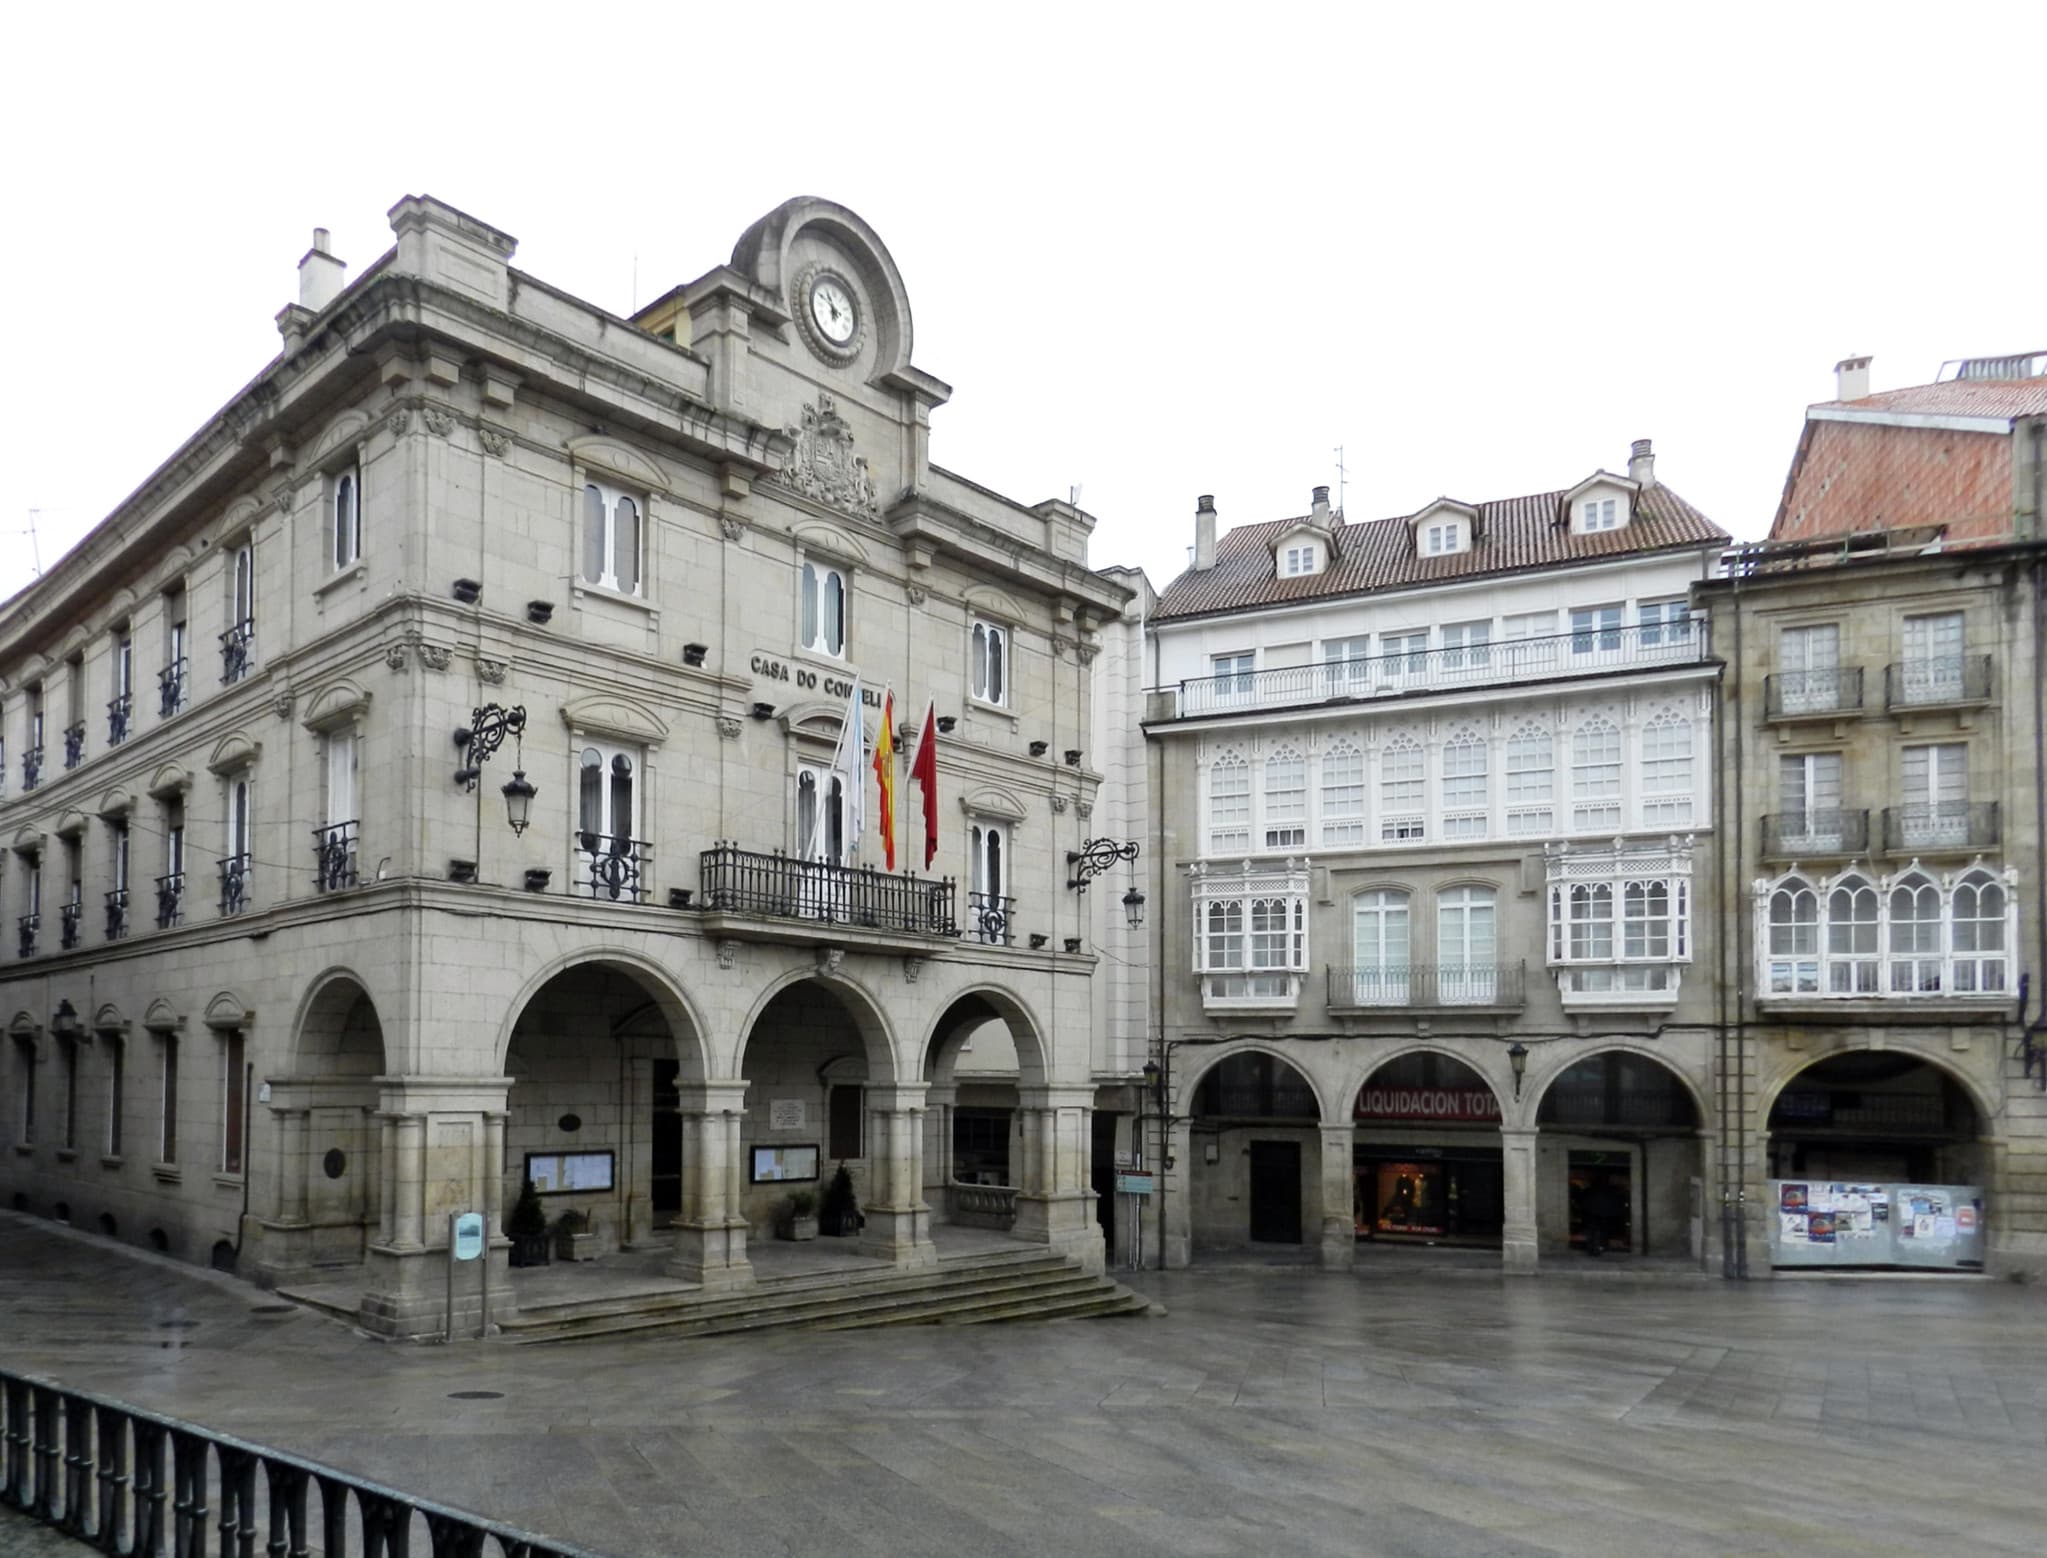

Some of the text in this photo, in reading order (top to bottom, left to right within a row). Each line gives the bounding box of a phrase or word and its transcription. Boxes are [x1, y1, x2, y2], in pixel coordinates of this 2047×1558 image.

[751, 656, 789, 681] CASA
[797, 669, 817, 689] DO
[1360, 1090, 1459, 1114] LIQUIDACION
